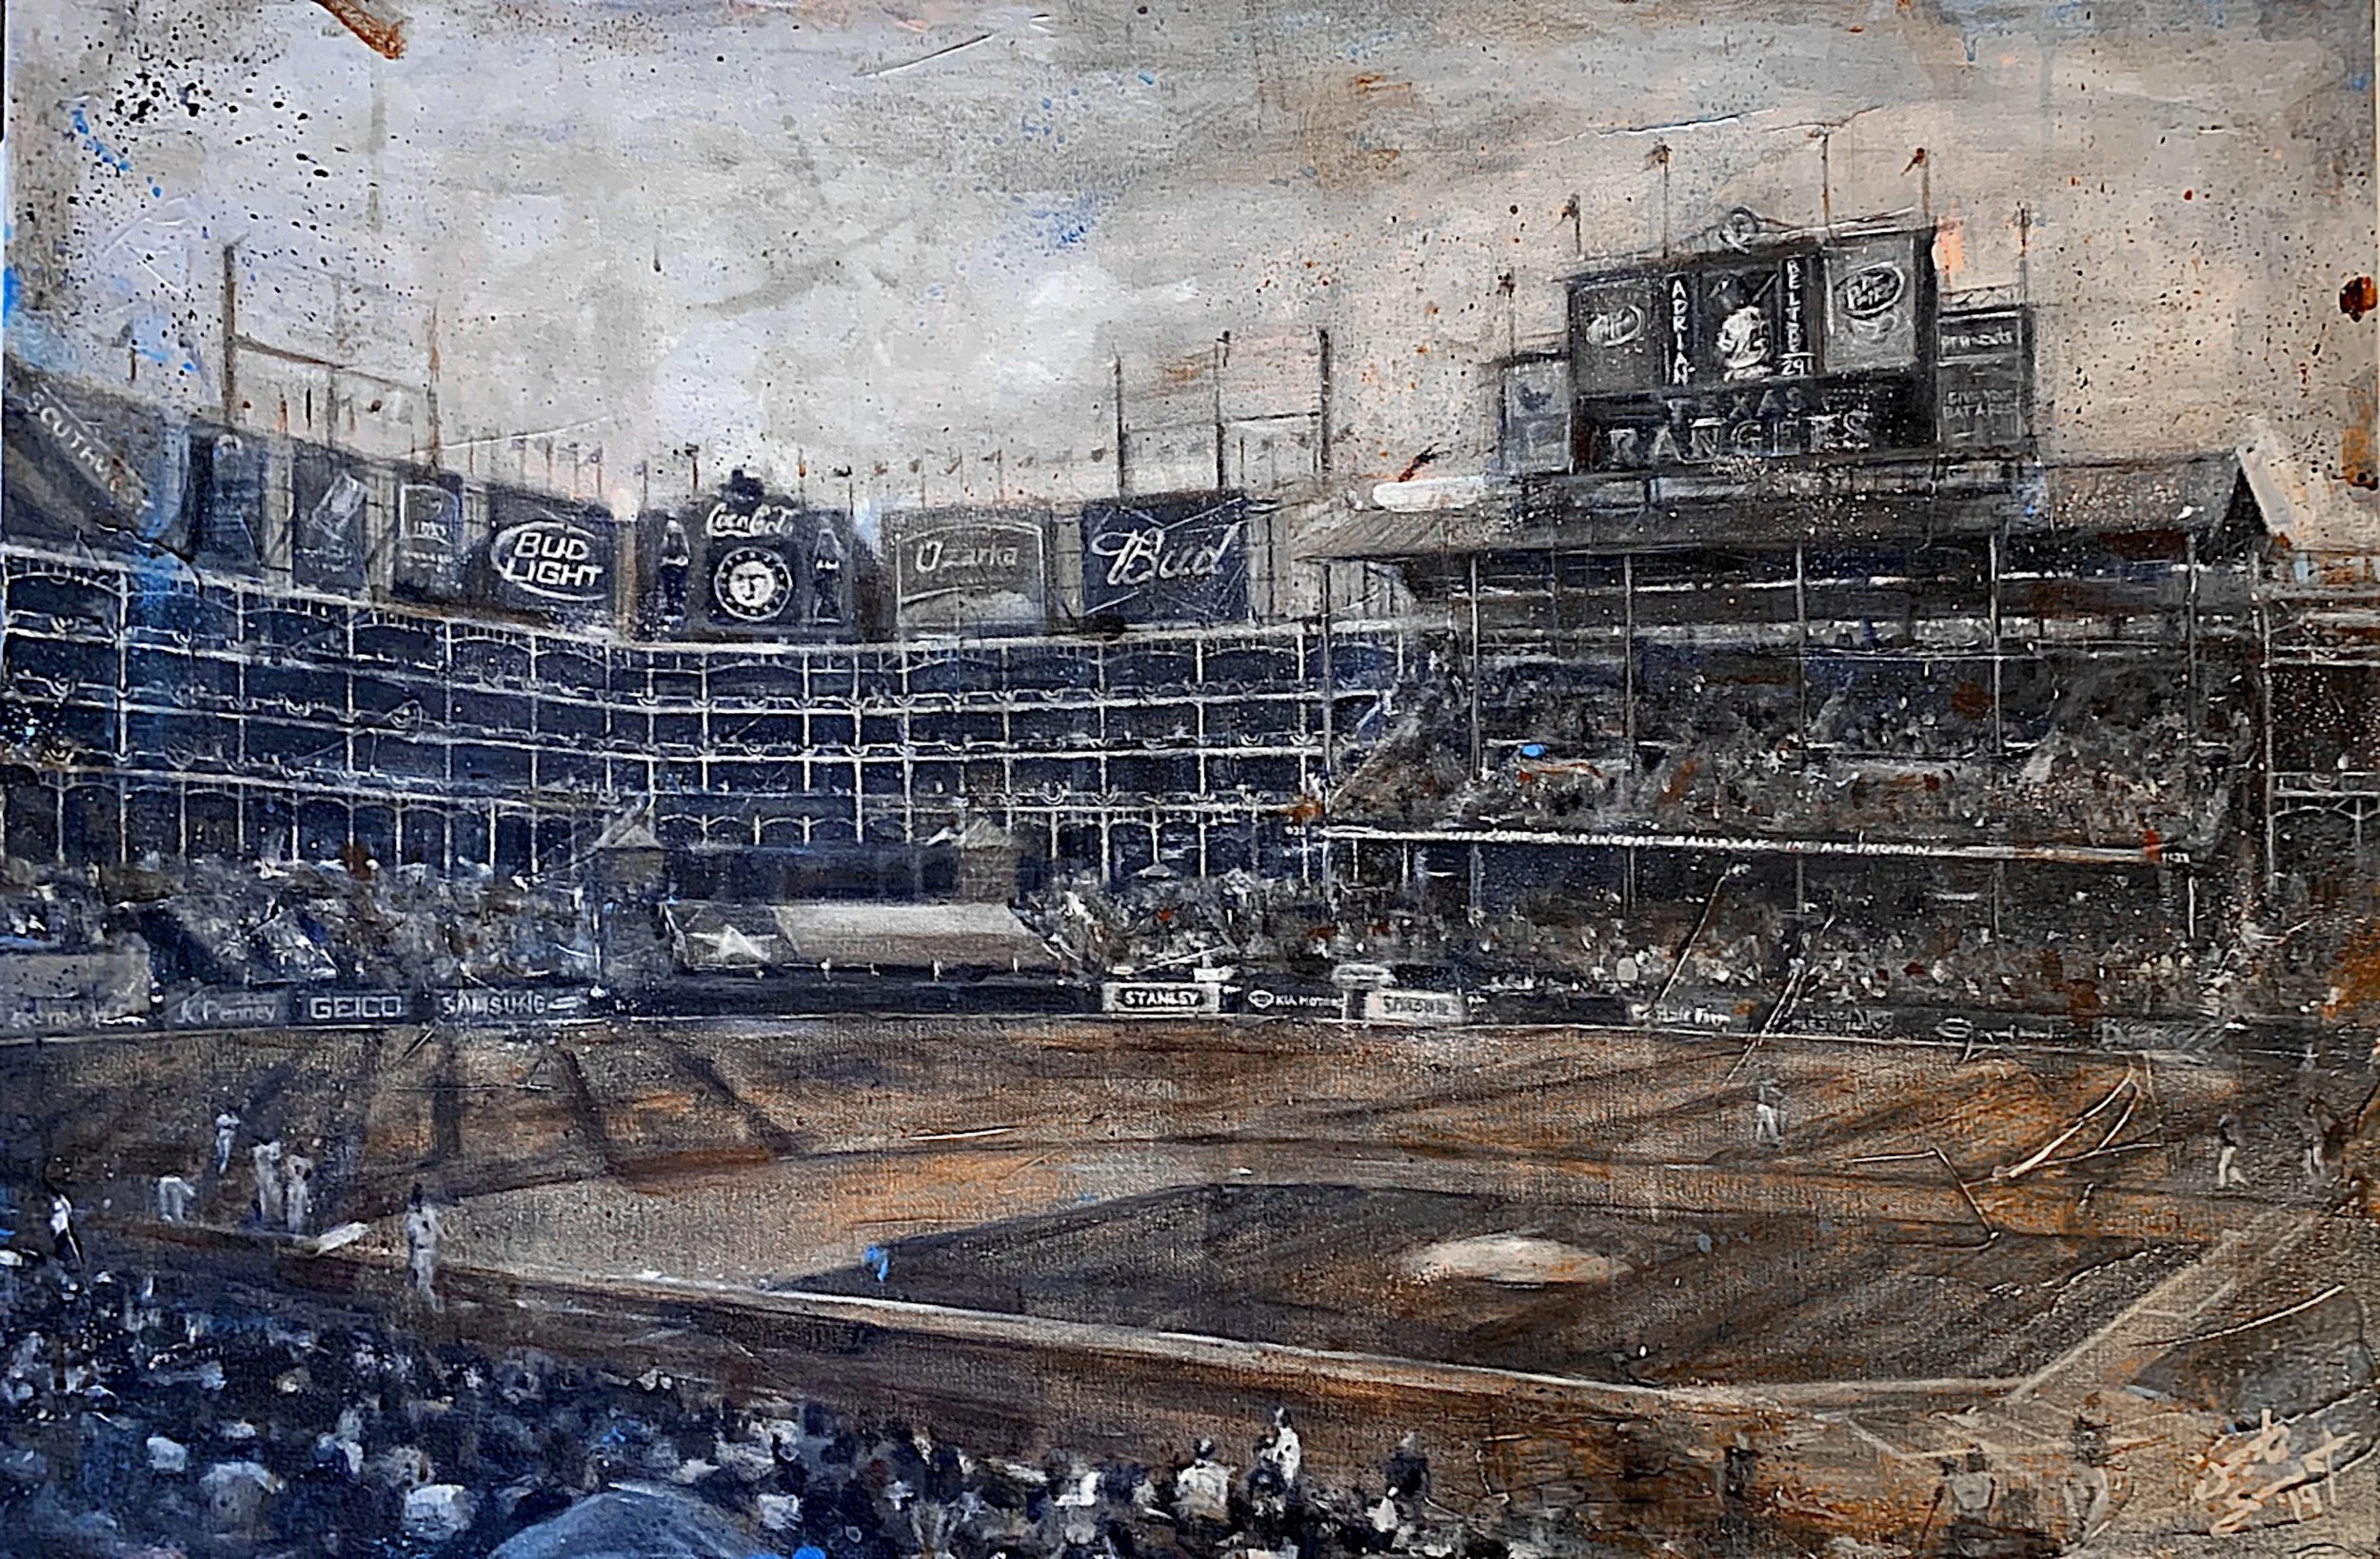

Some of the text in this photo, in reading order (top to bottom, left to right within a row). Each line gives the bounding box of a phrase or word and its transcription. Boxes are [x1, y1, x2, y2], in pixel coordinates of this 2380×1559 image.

[1780, 358, 1805, 377] 29
[514, 531, 590, 561] BUD
[1092, 522, 1240, 586] Bud
[503, 557, 605, 587] LIGHT
[309, 996, 403, 1019] GEICO
